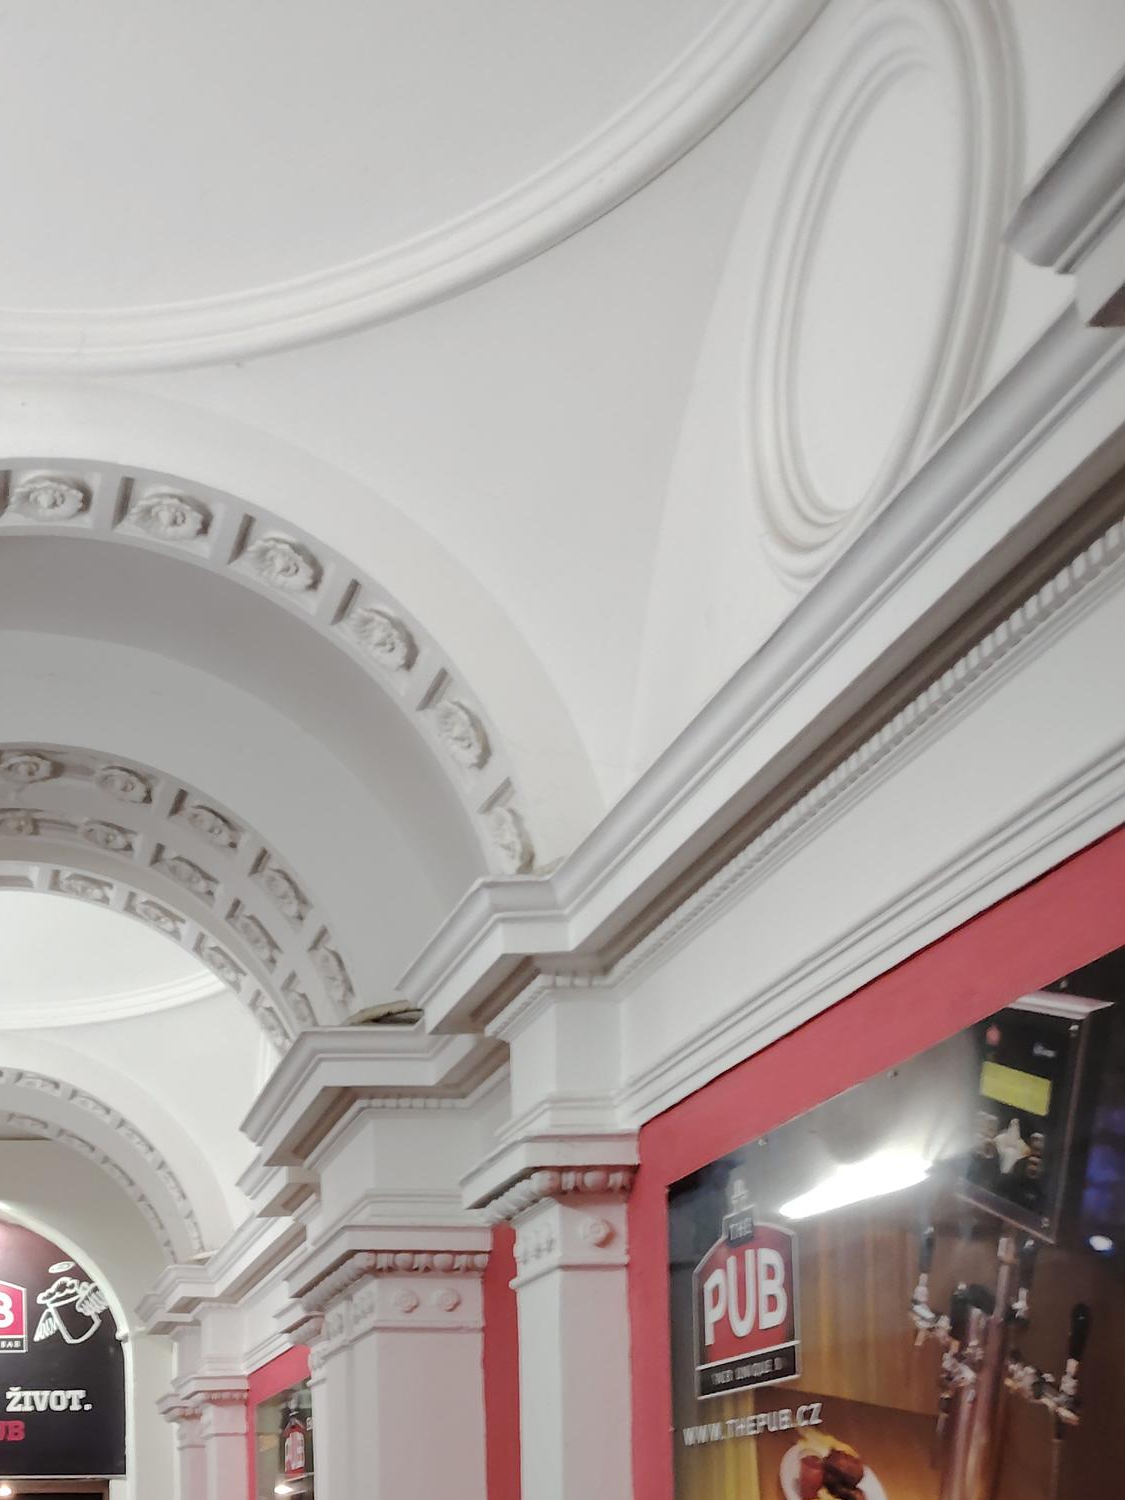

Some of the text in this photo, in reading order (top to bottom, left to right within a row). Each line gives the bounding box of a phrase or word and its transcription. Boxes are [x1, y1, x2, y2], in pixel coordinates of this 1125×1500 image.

[703, 1247, 787, 1346] PUB
[0, 1340, 21, 1348] BAR
[6, 1386, 93, 1412] ŽIVOT.
